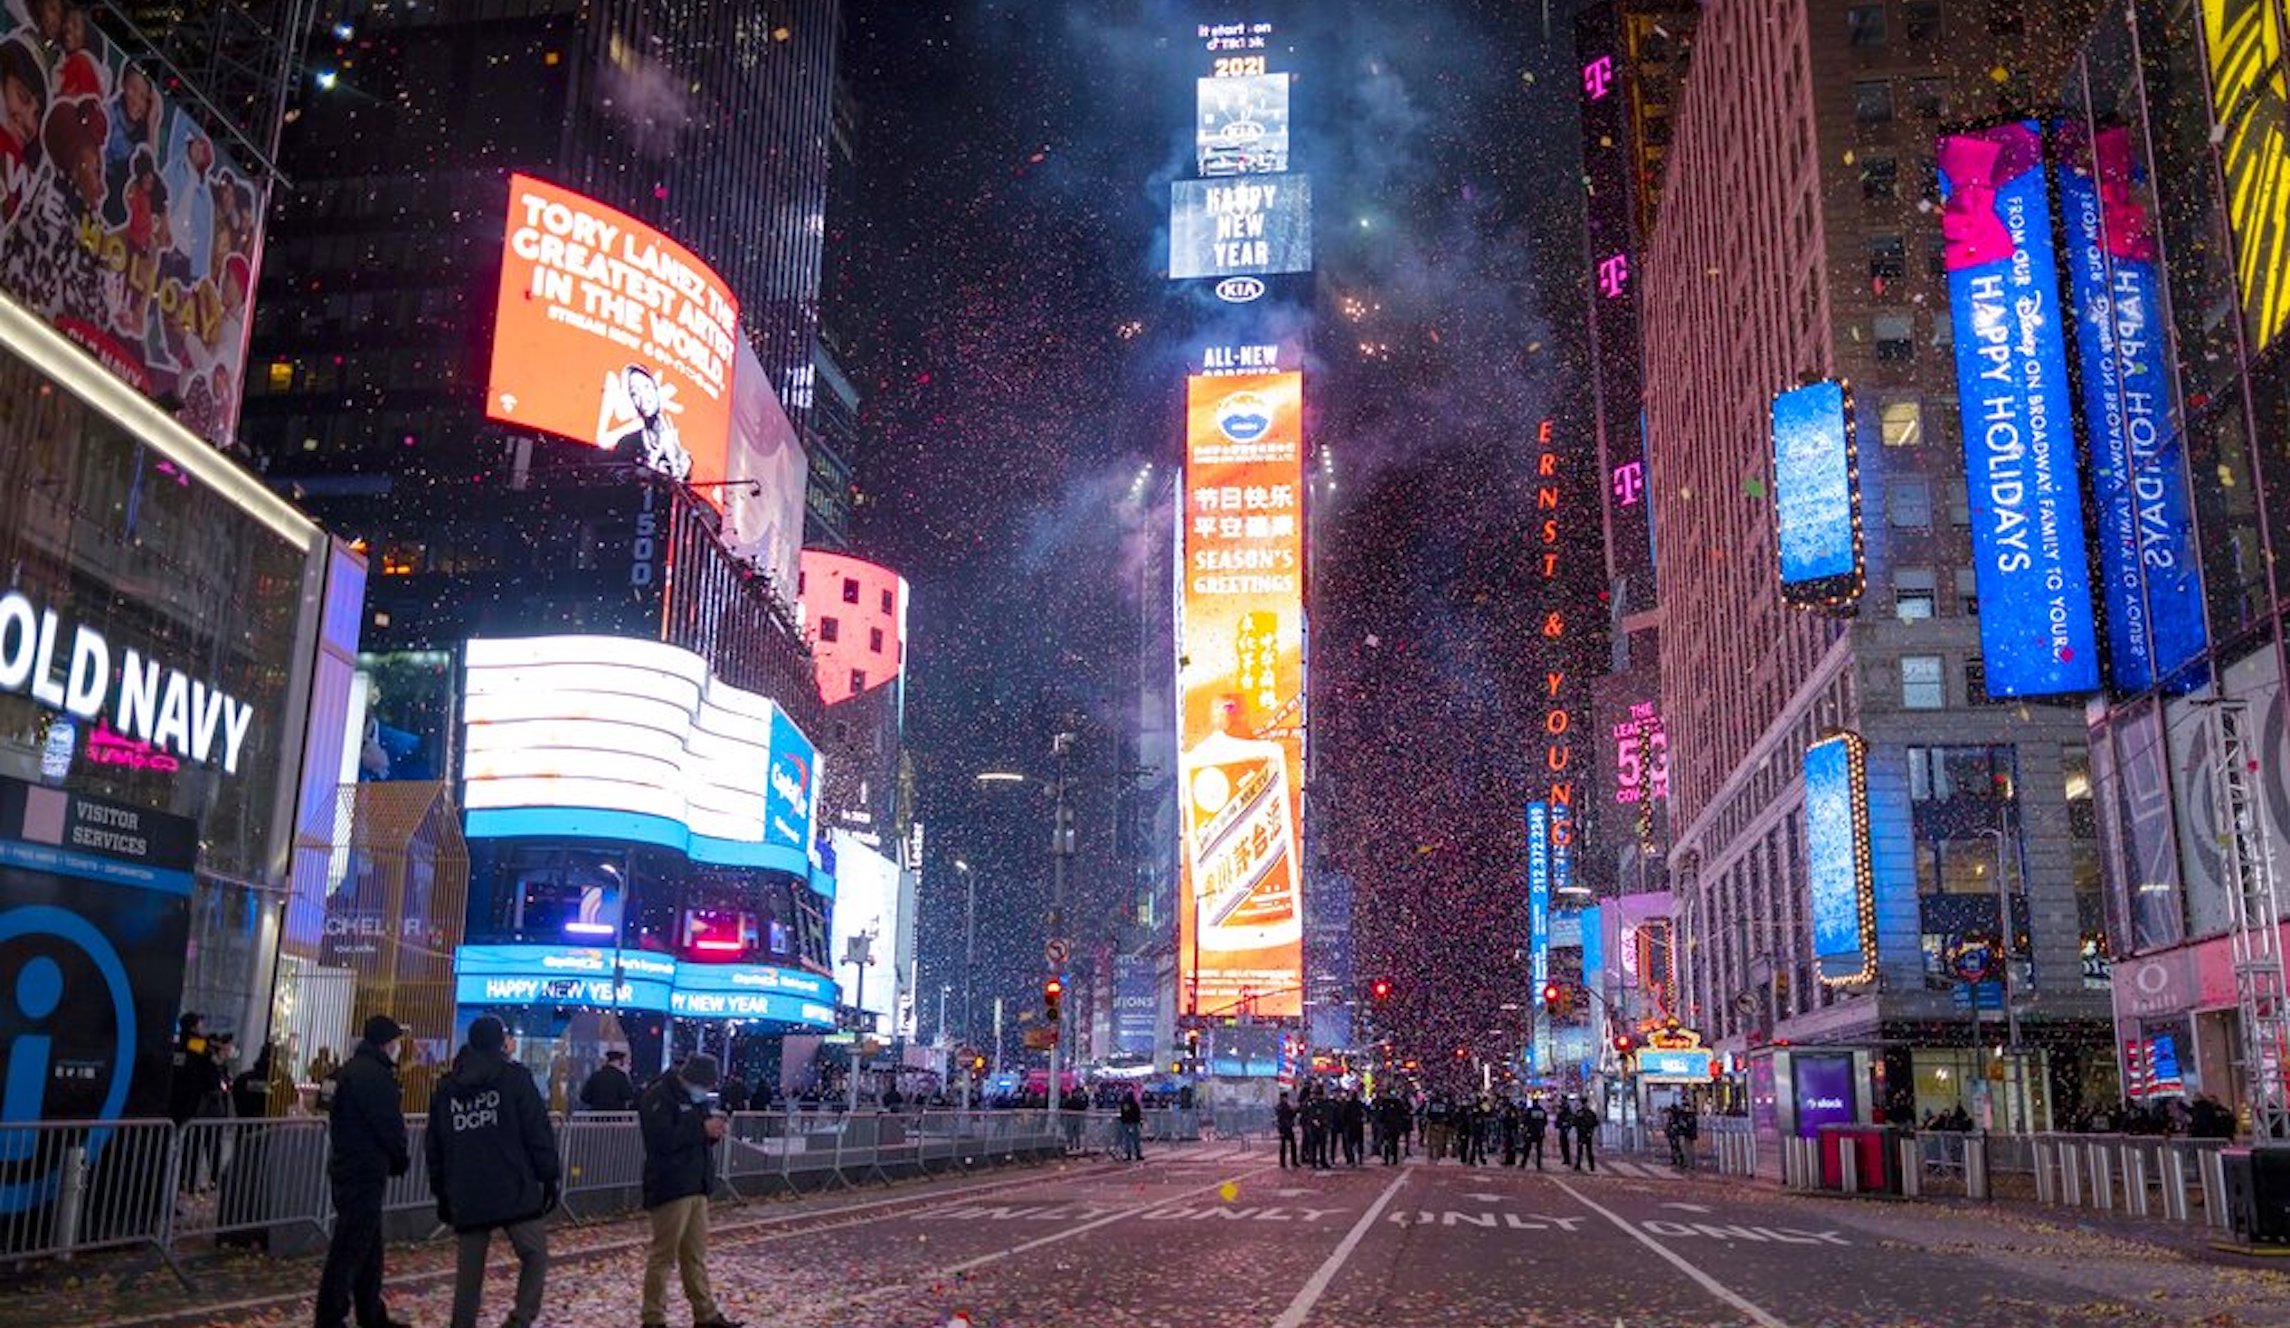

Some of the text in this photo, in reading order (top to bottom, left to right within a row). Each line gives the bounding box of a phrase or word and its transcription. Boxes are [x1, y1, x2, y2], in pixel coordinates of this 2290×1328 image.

[1214, 56, 1265, 77] 2021
[1584, 55, 1613, 99] T
[1217, 213, 1265, 238] NEW
[2008, 195, 2025, 245] FROM
[521, 193, 737, 338] TORY LANEZ THE
[1214, 242, 1270, 267] YEAR
[2012, 249, 2032, 287] OUR
[511, 226, 676, 314] GREATEST
[1600, 254, 1628, 298] T
[531, 265, 574, 306] IN
[580, 281, 646, 334] THE
[1224, 282, 1257, 298] KIA
[1203, 345, 1278, 368] ALL-NEW
[2025, 360, 2045, 389] ON
[1971, 274, 2032, 573] HAPPY HOLIDAYS
[2028, 394, 2054, 500] BROADWAY
[1194, 484, 1294, 511] 节日快乐
[1613, 461, 1642, 505] T
[1538, 418, 1558, 579] ERNST
[631, 487, 654, 586] 1500
[2038, 499, 2062, 561] FAMILY
[1194, 550, 1295, 570] SEASON'S
[1193, 574, 1294, 593] GREETINGS
[2046, 567, 2064, 591] TO
[1541, 611, 1564, 637] &
[0, 593, 109, 718] OLD
[117, 649, 254, 776] NAVY
[1630, 702, 1654, 719] THE
[1547, 670, 1572, 847] YOUNG
[77, 800, 140, 831] VISITOR
[73, 826, 147, 856] SERVICES
[485, 978, 539, 999] HAPPY
[541, 979, 586, 1000] NEW
[687, 993, 726, 1013] NEW
[727, 996, 769, 1015] YEAR
[453, 1109, 498, 1131] DCPI
[1141, 1206, 1347, 1222] ONLY
[1388, 1210, 1587, 1232] ONLY
[1641, 1218, 1853, 1246] ONLY
